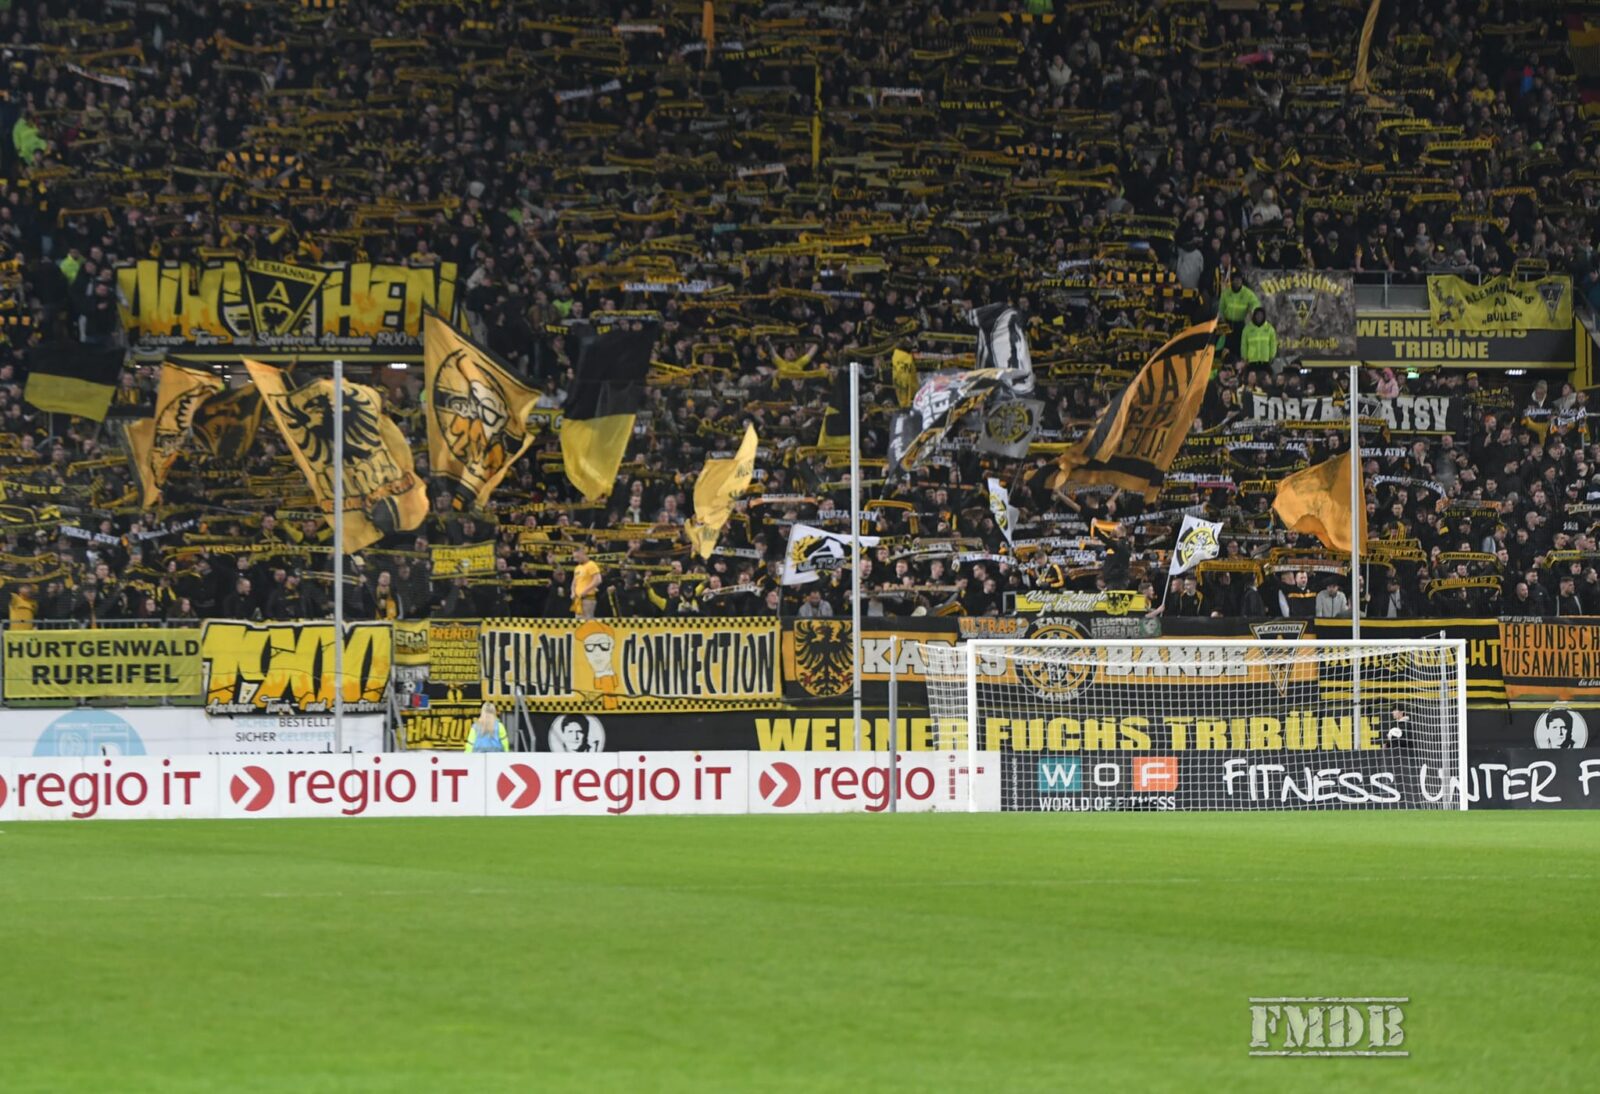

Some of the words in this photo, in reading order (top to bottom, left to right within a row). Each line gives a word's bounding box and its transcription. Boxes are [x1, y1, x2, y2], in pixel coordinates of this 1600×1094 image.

[1357, 320, 1447, 337] WERNE
[1392, 338, 1490, 359] TRIBÜNE
[1381, 396, 1450, 430] ATSV
[958, 617, 1017, 633] ULTRAS
[1257, 625, 1301, 633] ALEMANNIA
[7, 638, 199, 658] HÜRTGENWALD
[32, 663, 179, 685] RUREIFEL
[481, 632, 573, 695] YELLOW
[623, 632, 775, 695] CONNECTION
[235, 732, 276, 742] SICHER
[755, 718, 969, 751] WERNER
[985, 717, 1152, 751] FUCHS
[1163, 711, 1382, 751] TRIBÜNE
[18, 759, 148, 818] regio
[288, 756, 418, 816] regio
[554, 754, 681, 814] regio
[814, 754, 936, 812] regio
[1223, 759, 1401, 802] FITNESS
[1419, 763, 1562, 803] UNTER
[1038, 797, 1090, 812] WORLD
[1093, 797, 1113, 812] OF
